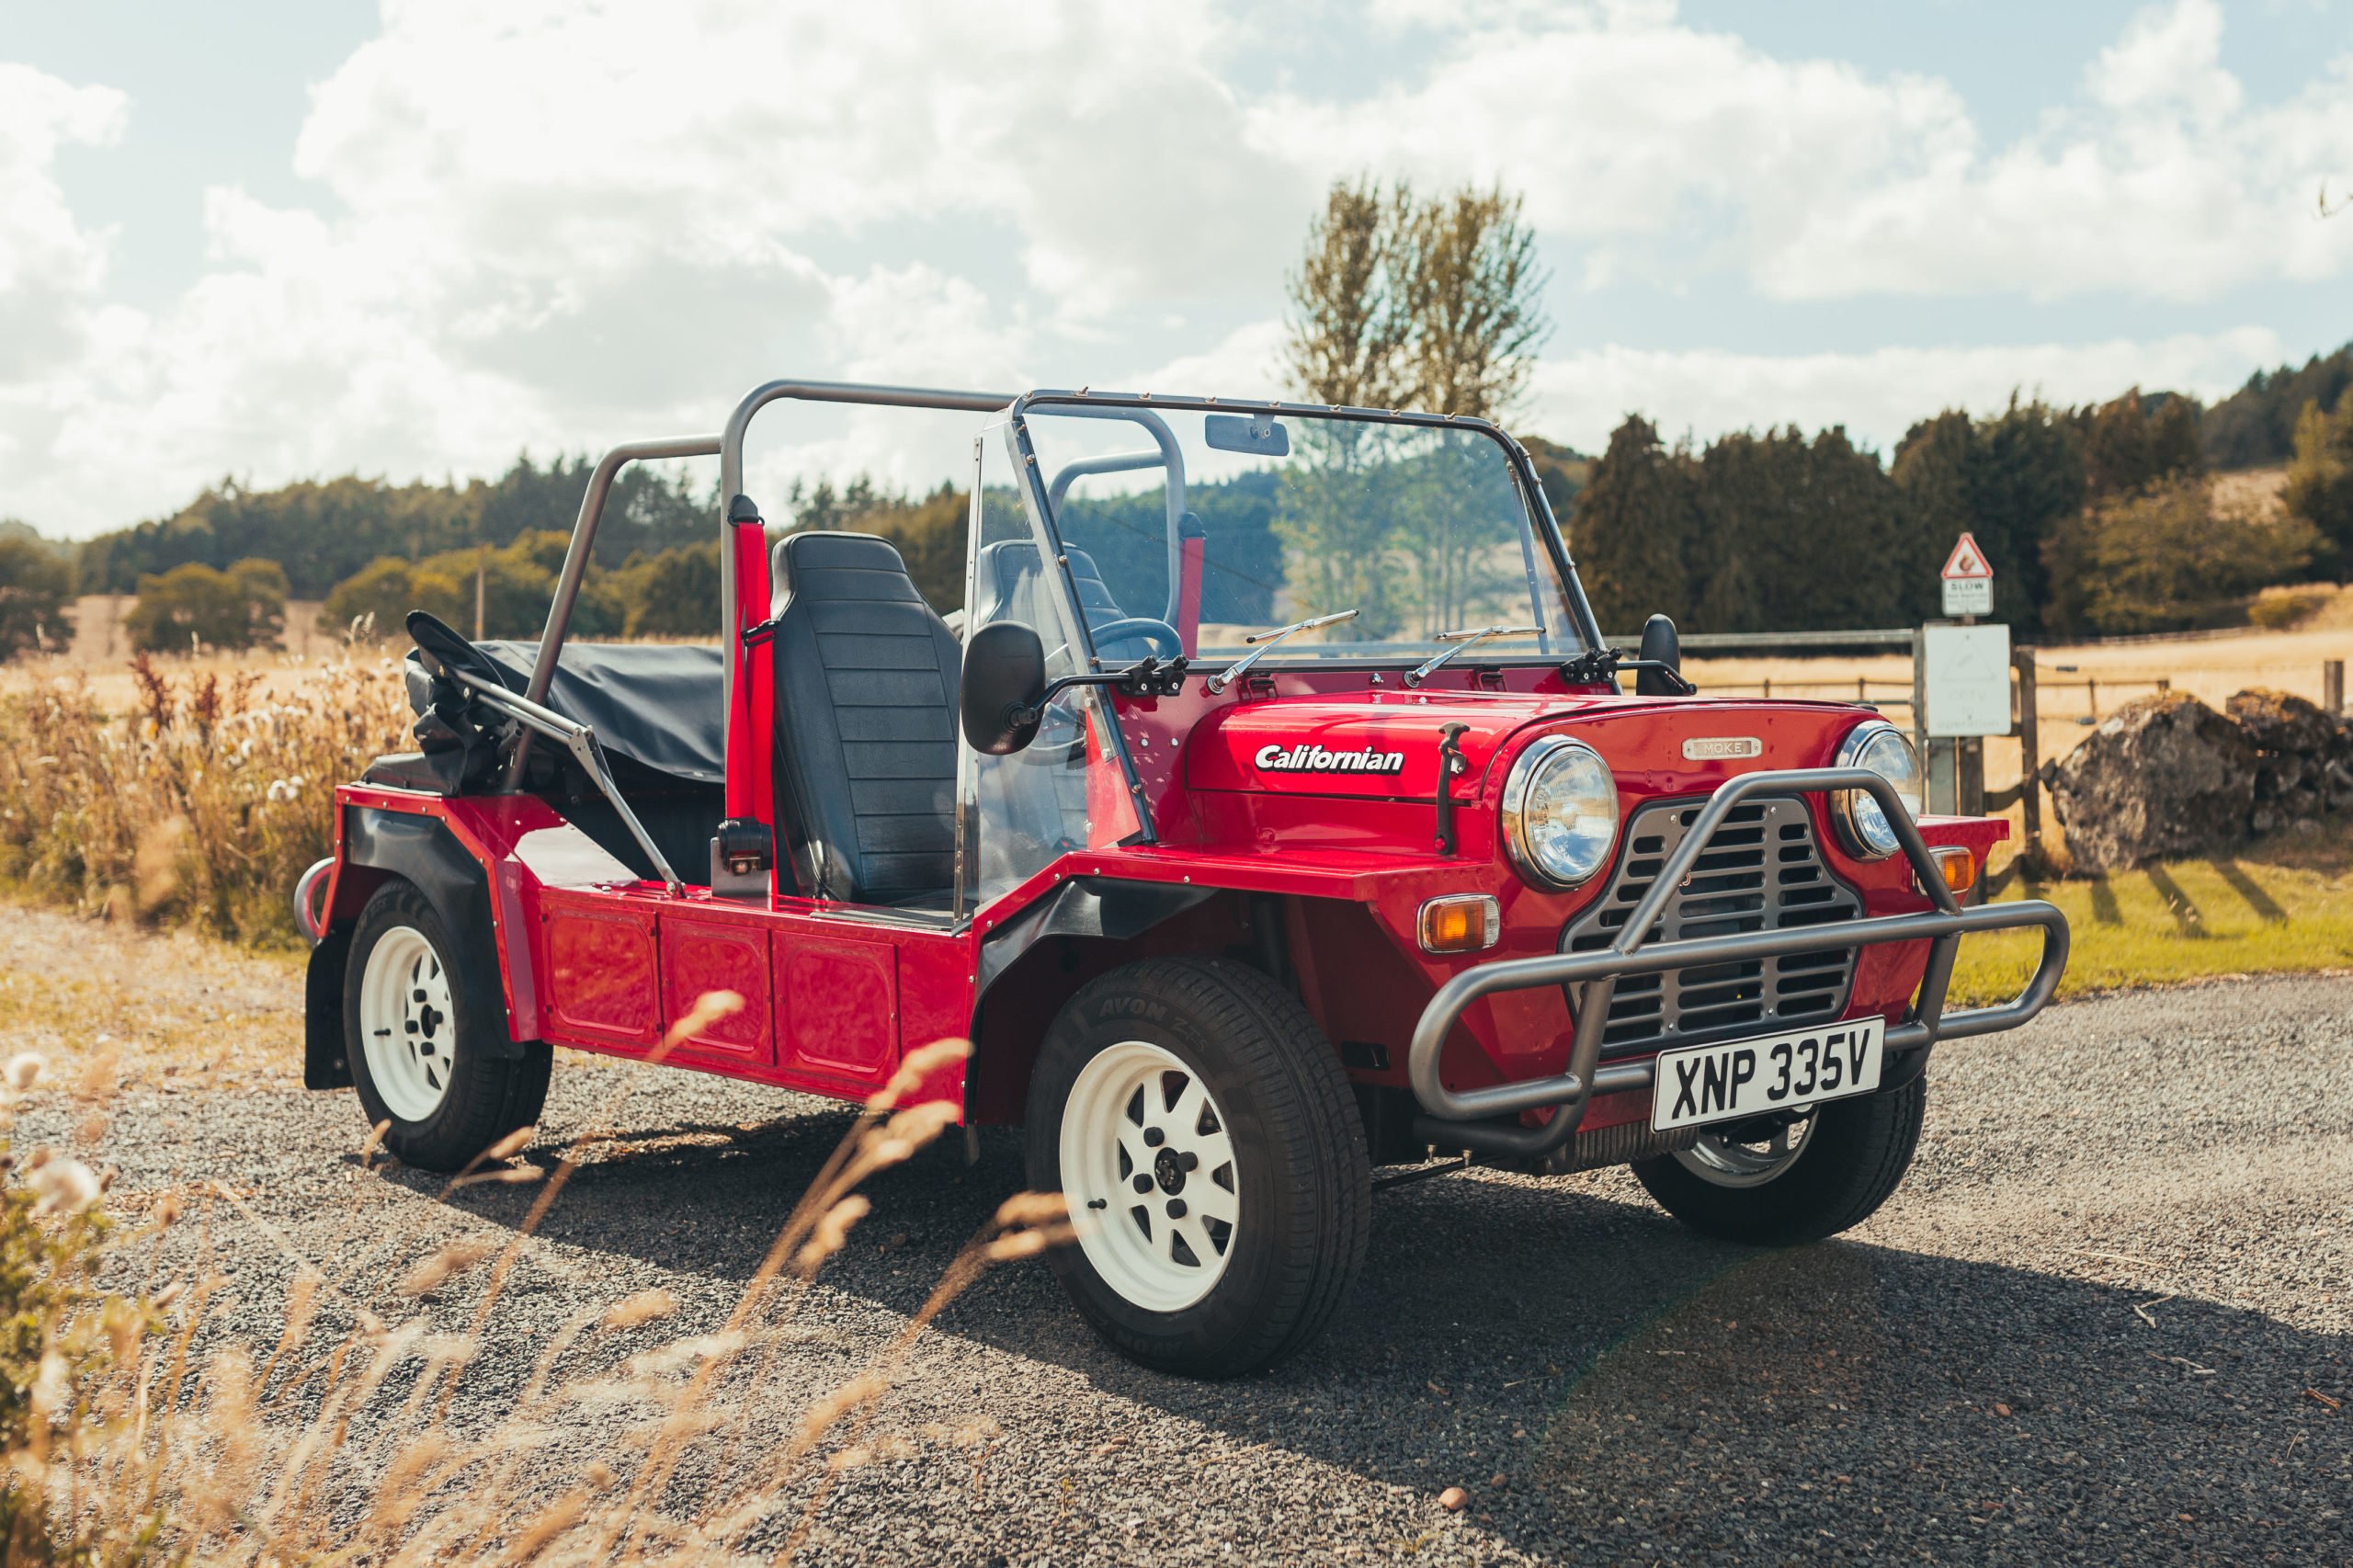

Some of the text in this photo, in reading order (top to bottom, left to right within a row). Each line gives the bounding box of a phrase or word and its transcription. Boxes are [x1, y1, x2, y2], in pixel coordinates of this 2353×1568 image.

[1950, 581, 1984, 590] SLOW
[1255, 744, 1404, 774] Californian
[1704, 743, 1743, 754] MOKE
[1099, 996, 1168, 1021] AVON
[1671, 1028, 1870, 1120] XNP 335V
